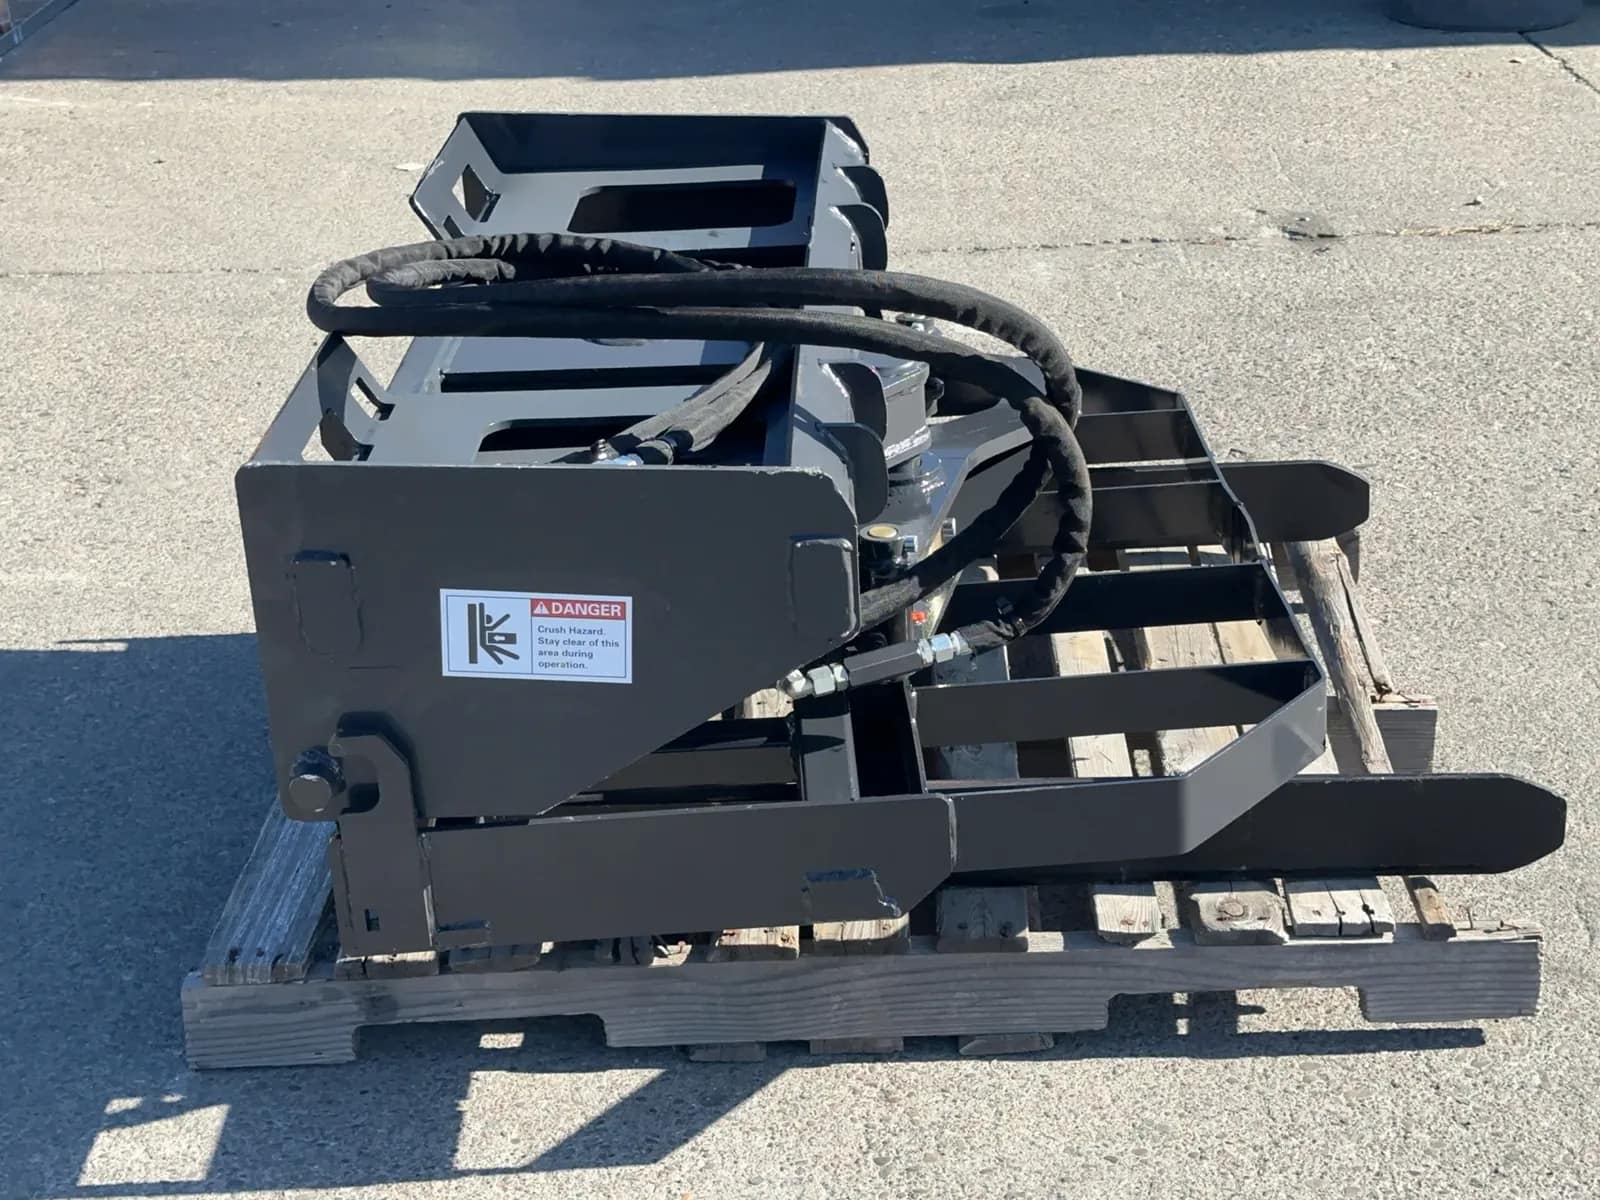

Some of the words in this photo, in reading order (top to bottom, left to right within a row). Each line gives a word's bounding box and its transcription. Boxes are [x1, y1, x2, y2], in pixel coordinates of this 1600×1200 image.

[551, 602, 622, 617] DANGER
[537, 625, 566, 634] Crush
[569, 626, 606, 636] Hazard.
[537, 637, 560, 647] Stay
[563, 638, 587, 647] clear
[590, 639, 600, 647] of
[602, 639, 620, 648] this
[562, 649, 594, 659] during
[538, 661, 588, 670] operation.
